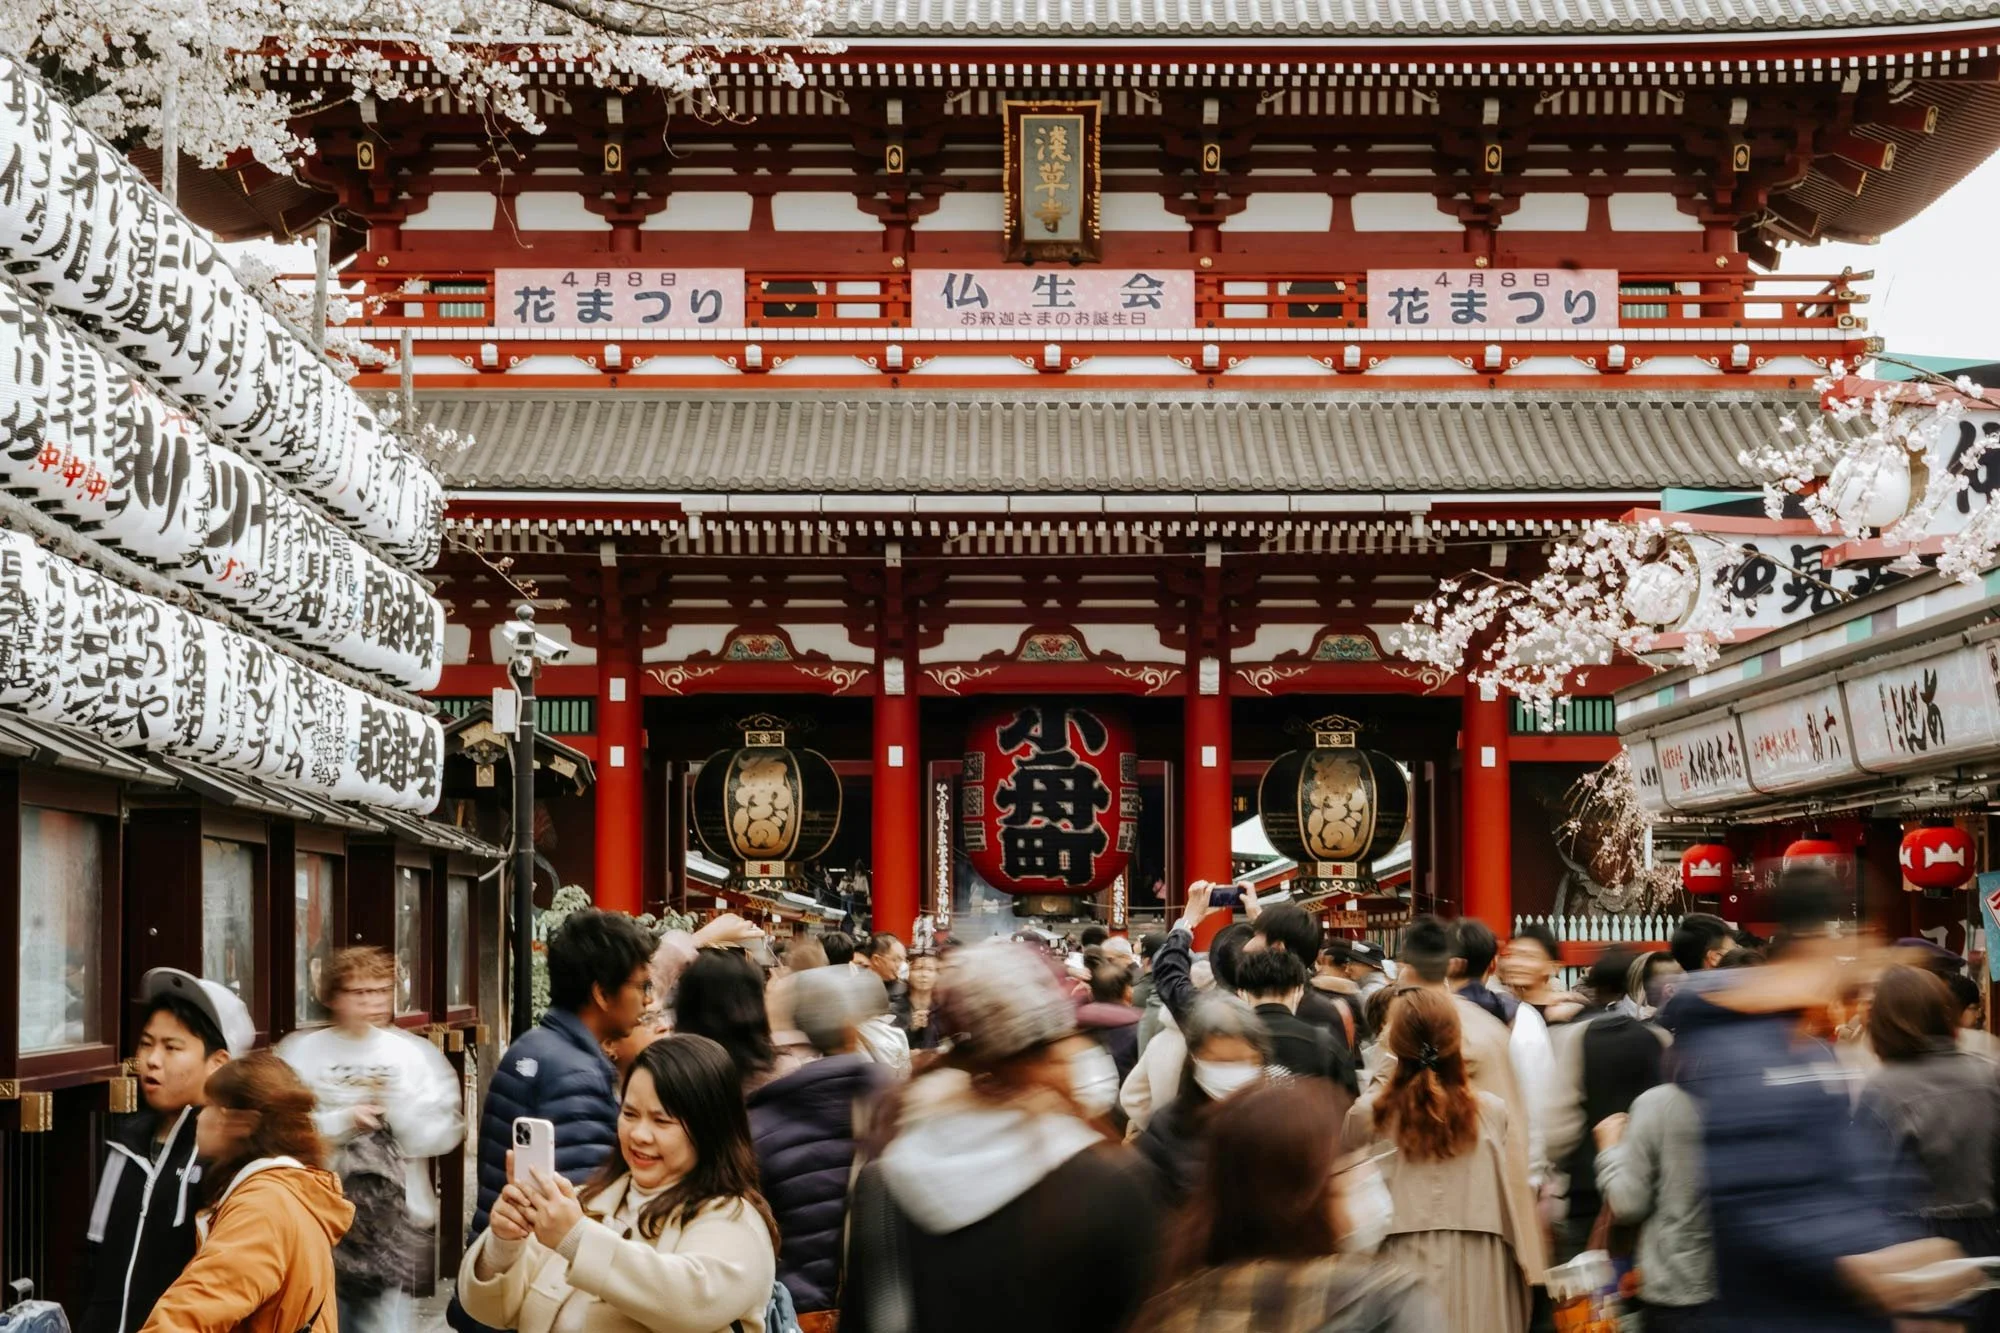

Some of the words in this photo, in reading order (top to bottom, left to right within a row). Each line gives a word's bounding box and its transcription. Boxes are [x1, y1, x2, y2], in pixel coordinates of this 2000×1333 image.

[561, 271, 677, 288] 4月8日
[941, 272, 1165, 310] 仏生会
[1435, 273, 1550, 288] 4月8日
[513, 286, 724, 325] 花まつり
[961, 311, 1147, 326] お釈迦さまのお誕生日
[1387, 287, 1597, 325] 花まつり
[994, 708, 1112, 887] 小舟町
